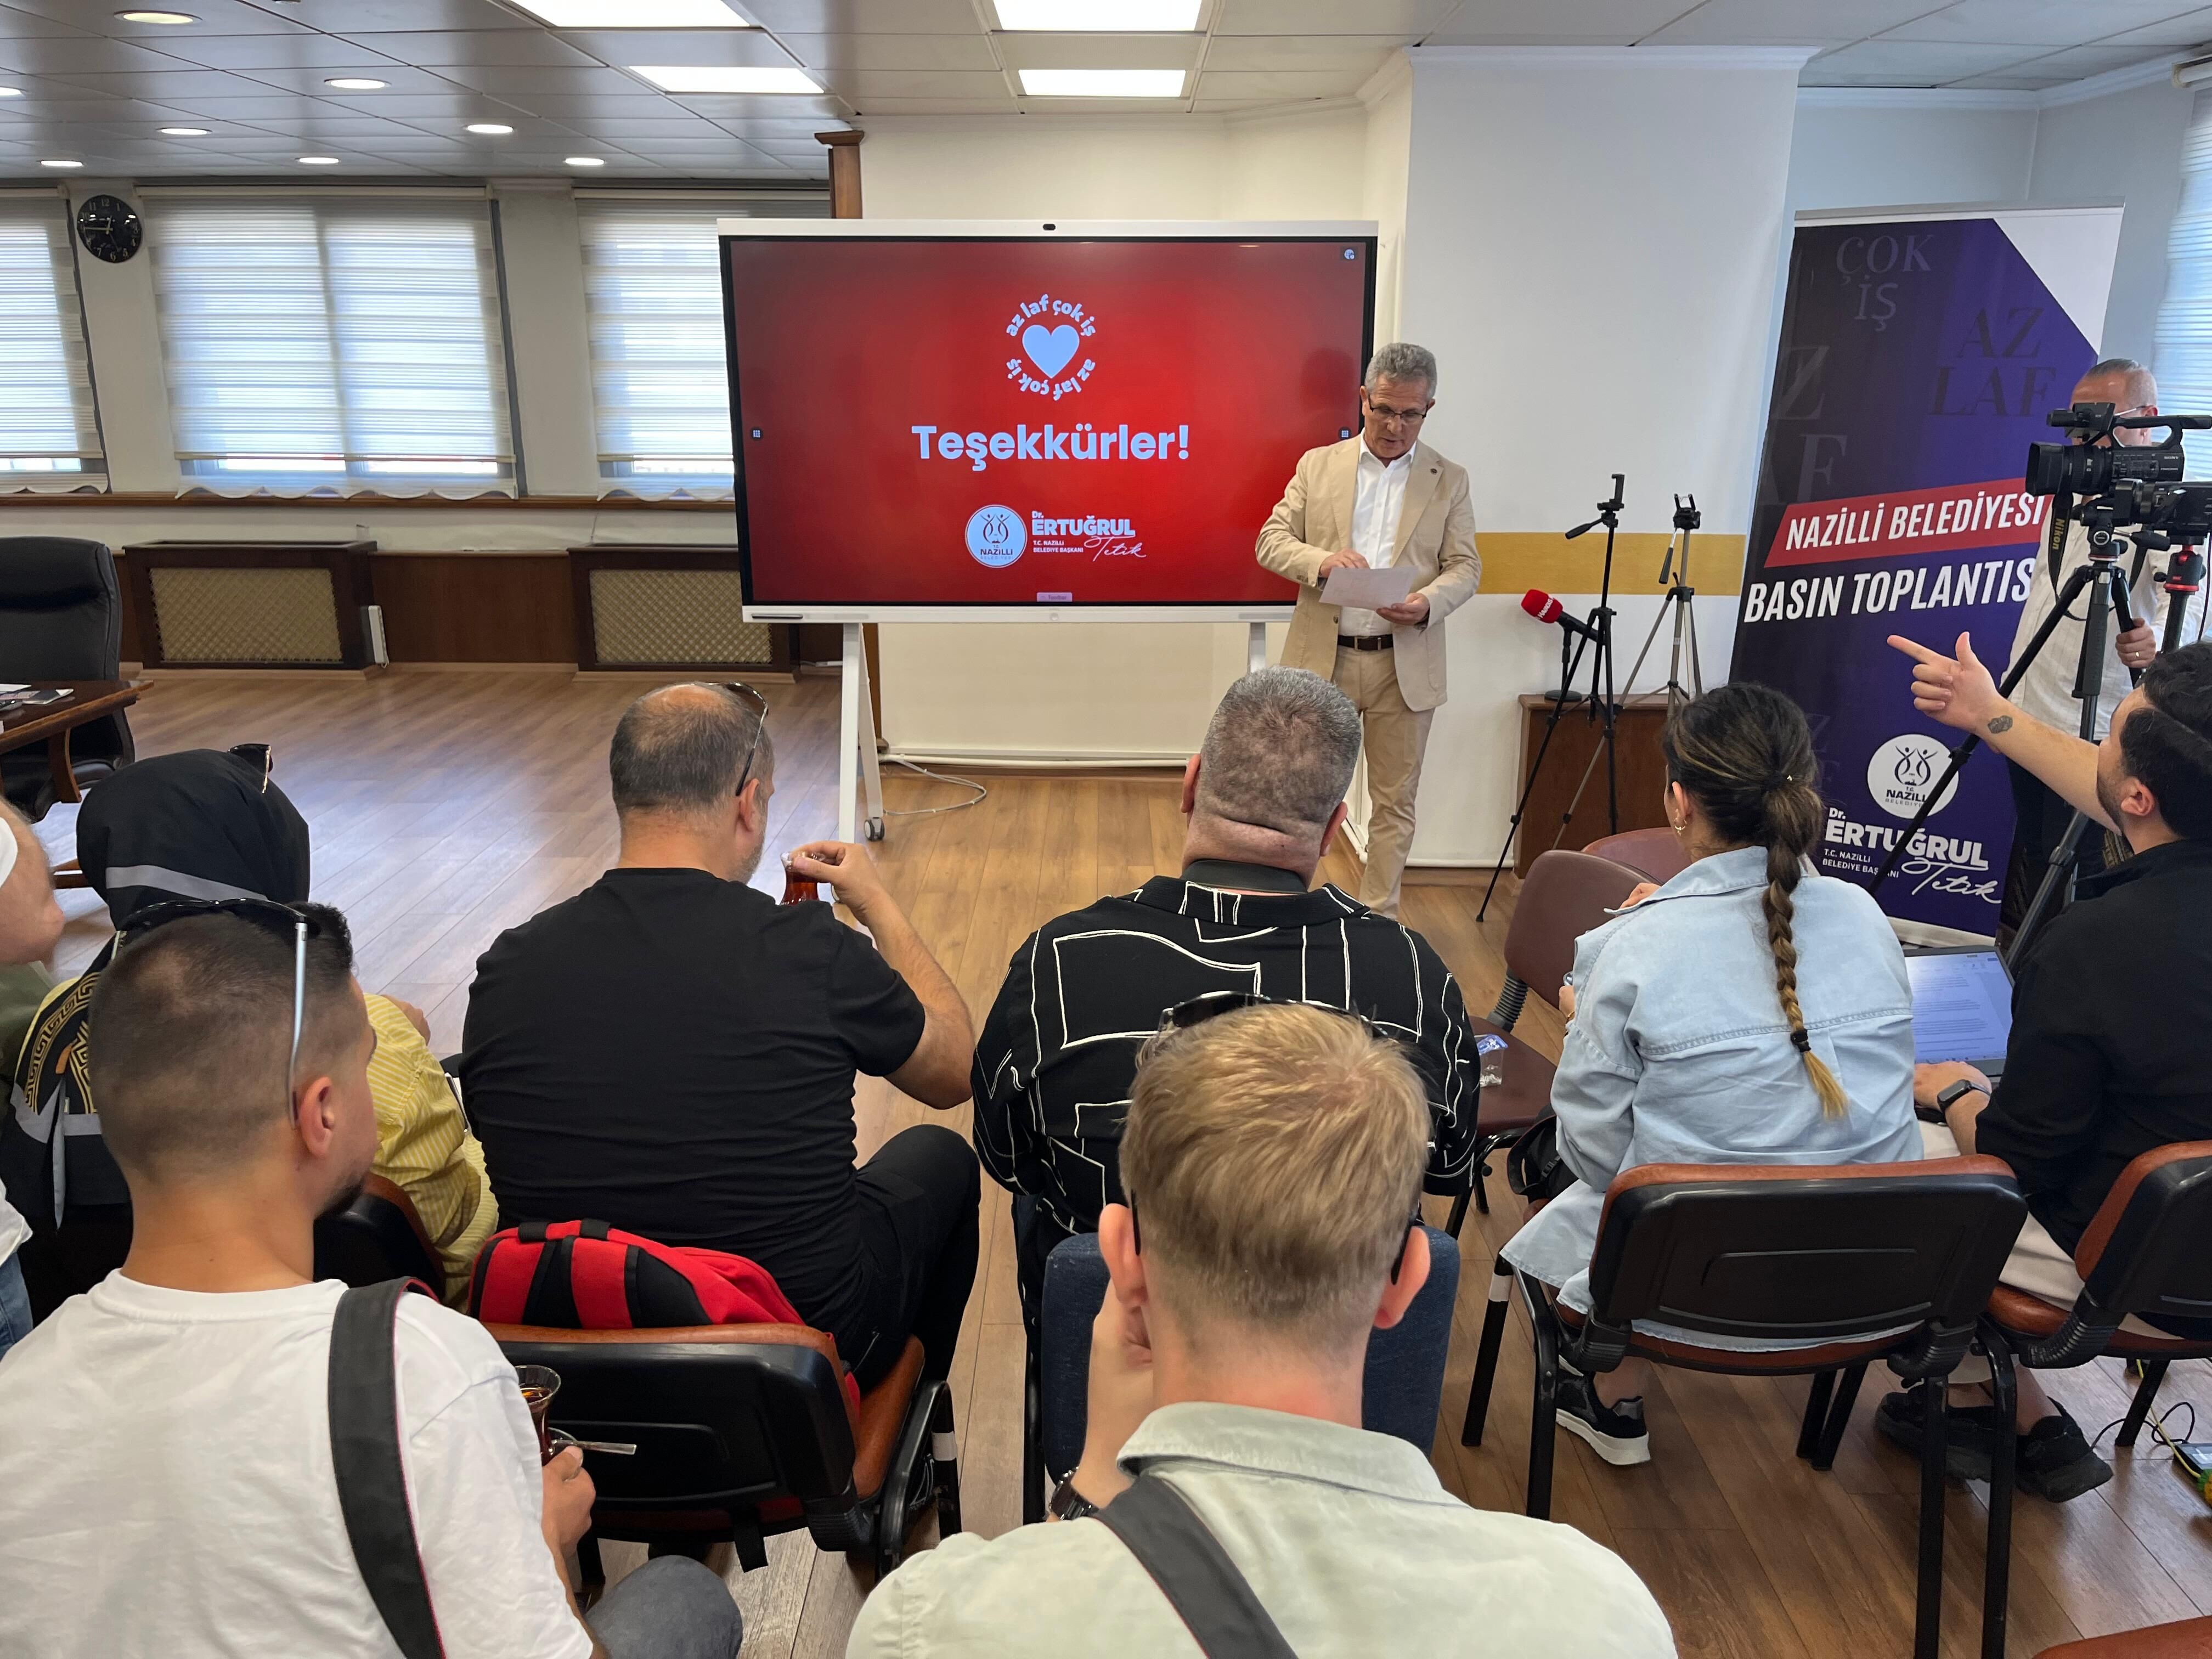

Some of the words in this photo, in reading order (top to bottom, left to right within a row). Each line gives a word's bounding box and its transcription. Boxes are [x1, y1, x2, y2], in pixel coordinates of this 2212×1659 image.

[89, 201, 96, 211] 11
[101, 198, 110, 207] 12
[116, 202, 121, 211] 1
[1836, 234, 1934, 285] ÇOK
[1854, 274, 1899, 332] İŞ
[1006, 314, 1025, 336] az
[1020, 294, 1048, 318] laf
[1052, 300, 1084, 322] çok
[1080, 316, 1096, 336] iş
[1956, 307, 2045, 359] AZ
[1006, 359, 1022, 379] iş
[1077, 359, 1096, 381] az
[1018, 373, 1049, 394] çok
[1053, 377, 1081, 400] laf
[1927, 366, 2056, 417] LAF
[911, 423, 1189, 471] Teşekkürler!
[1032, 516, 1136, 536] ERTUĞRUL
[1786, 503, 1884, 550] NAZİLLİ
[2052, 518, 2065, 550] Nikon
[1744, 575, 1844, 623] BASIN
[1851, 557, 2036, 614] TOPLANTIS
[1829, 808, 1846, 820] Dr.
[1824, 849, 1837, 857] T.C.
[1825, 819, 1989, 868] ERTUĞRUL
[1862, 865, 1899, 878] BAŞNI
